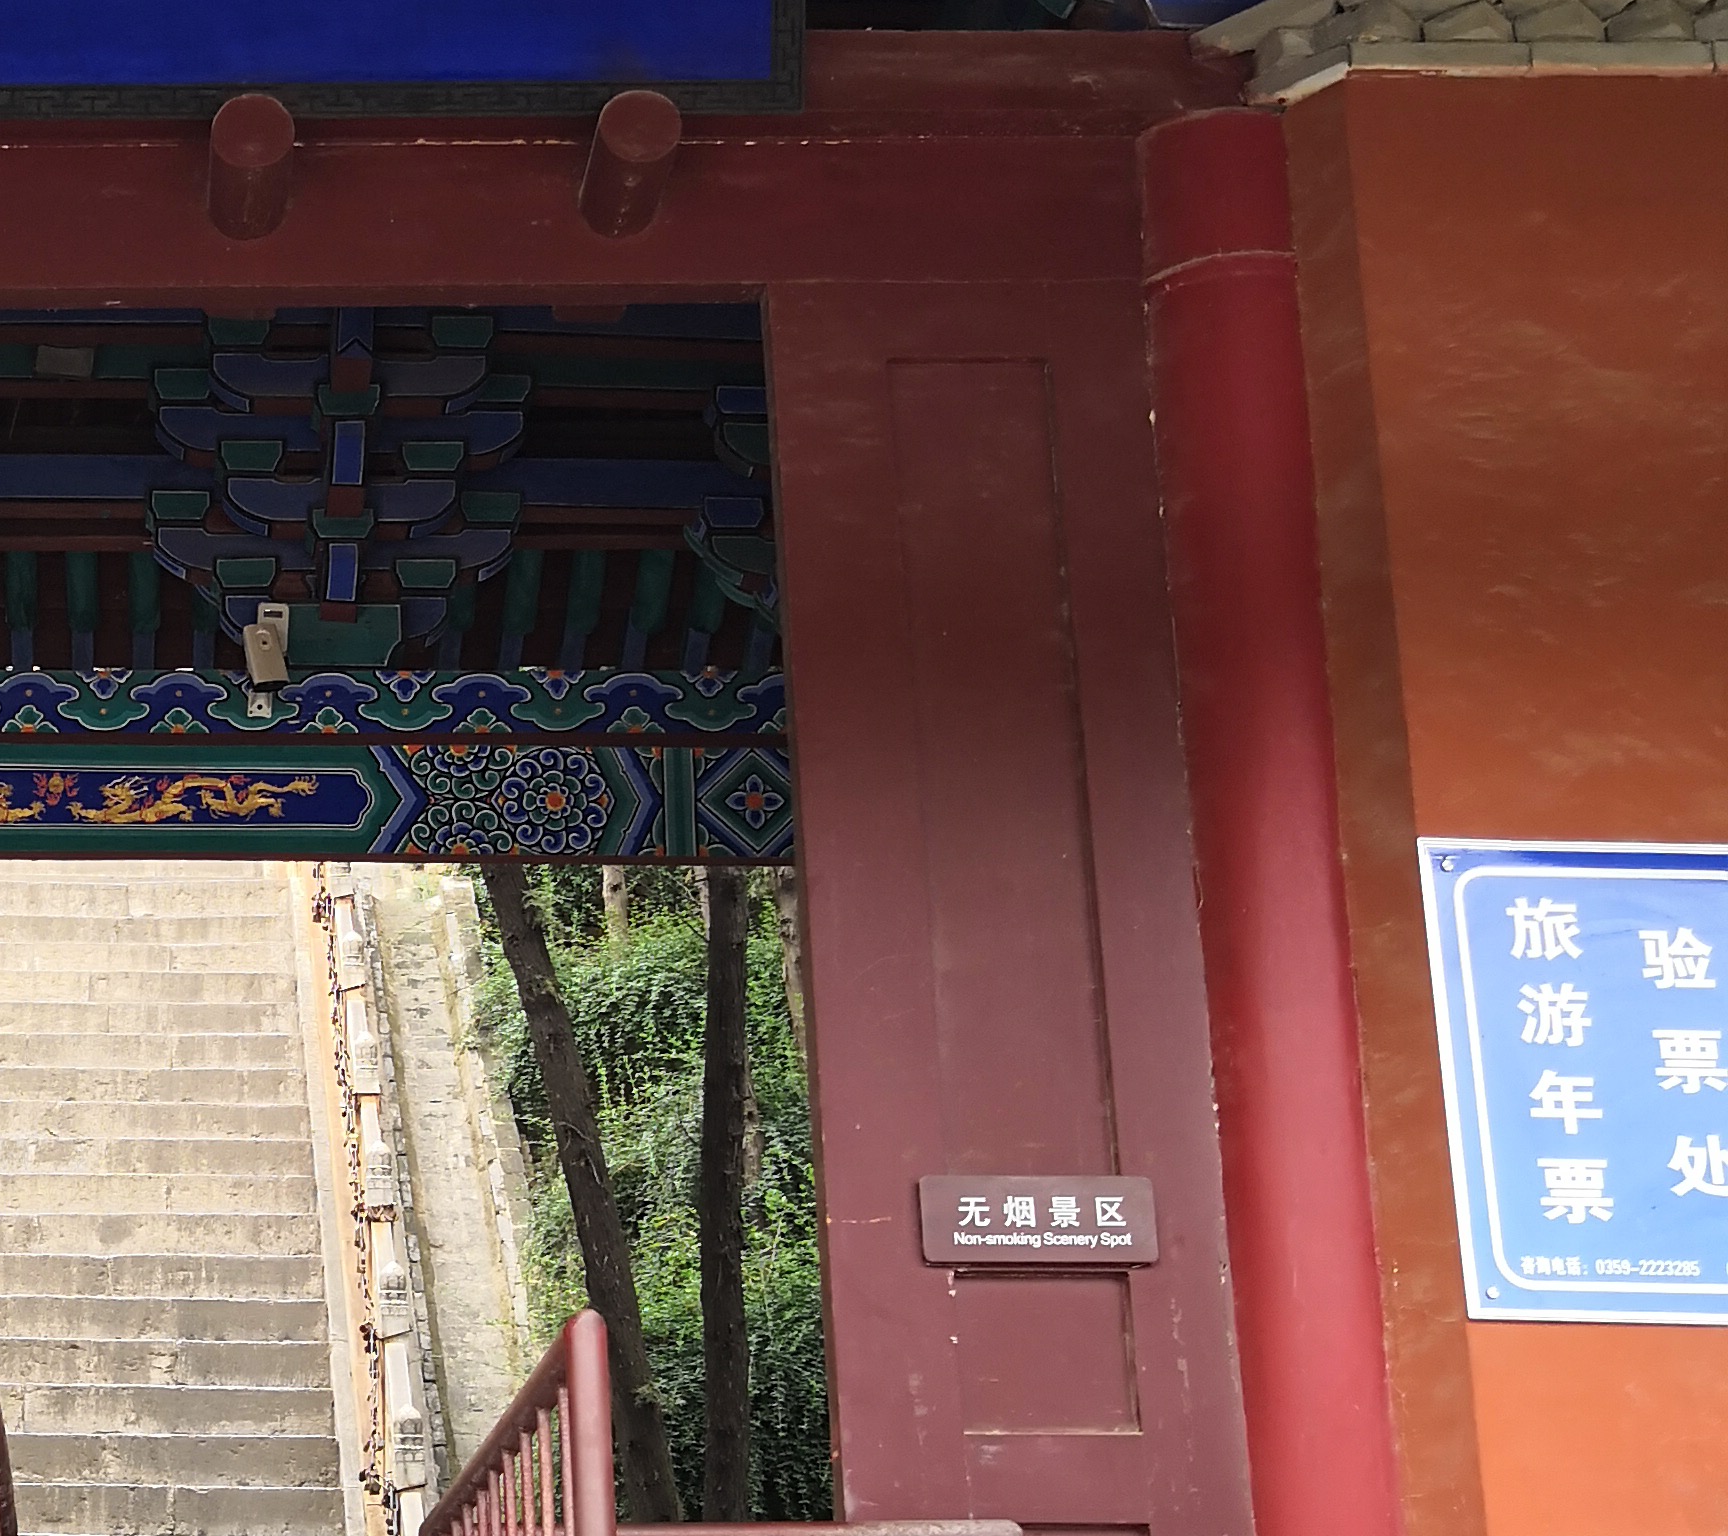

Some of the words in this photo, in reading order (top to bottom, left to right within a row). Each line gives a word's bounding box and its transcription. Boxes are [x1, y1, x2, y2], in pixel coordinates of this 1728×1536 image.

[1505, 896, 1615, 1225] 旅游年票
[1638, 926, 1728, 1198] 验票处
[954, 1231, 1041, 1248] Non-smoking
[1043, 1233, 1098, 1249] Scenery
[1100, 1233, 1132, 1249] Spot
[957, 1196, 1127, 1228] 无烟景区
